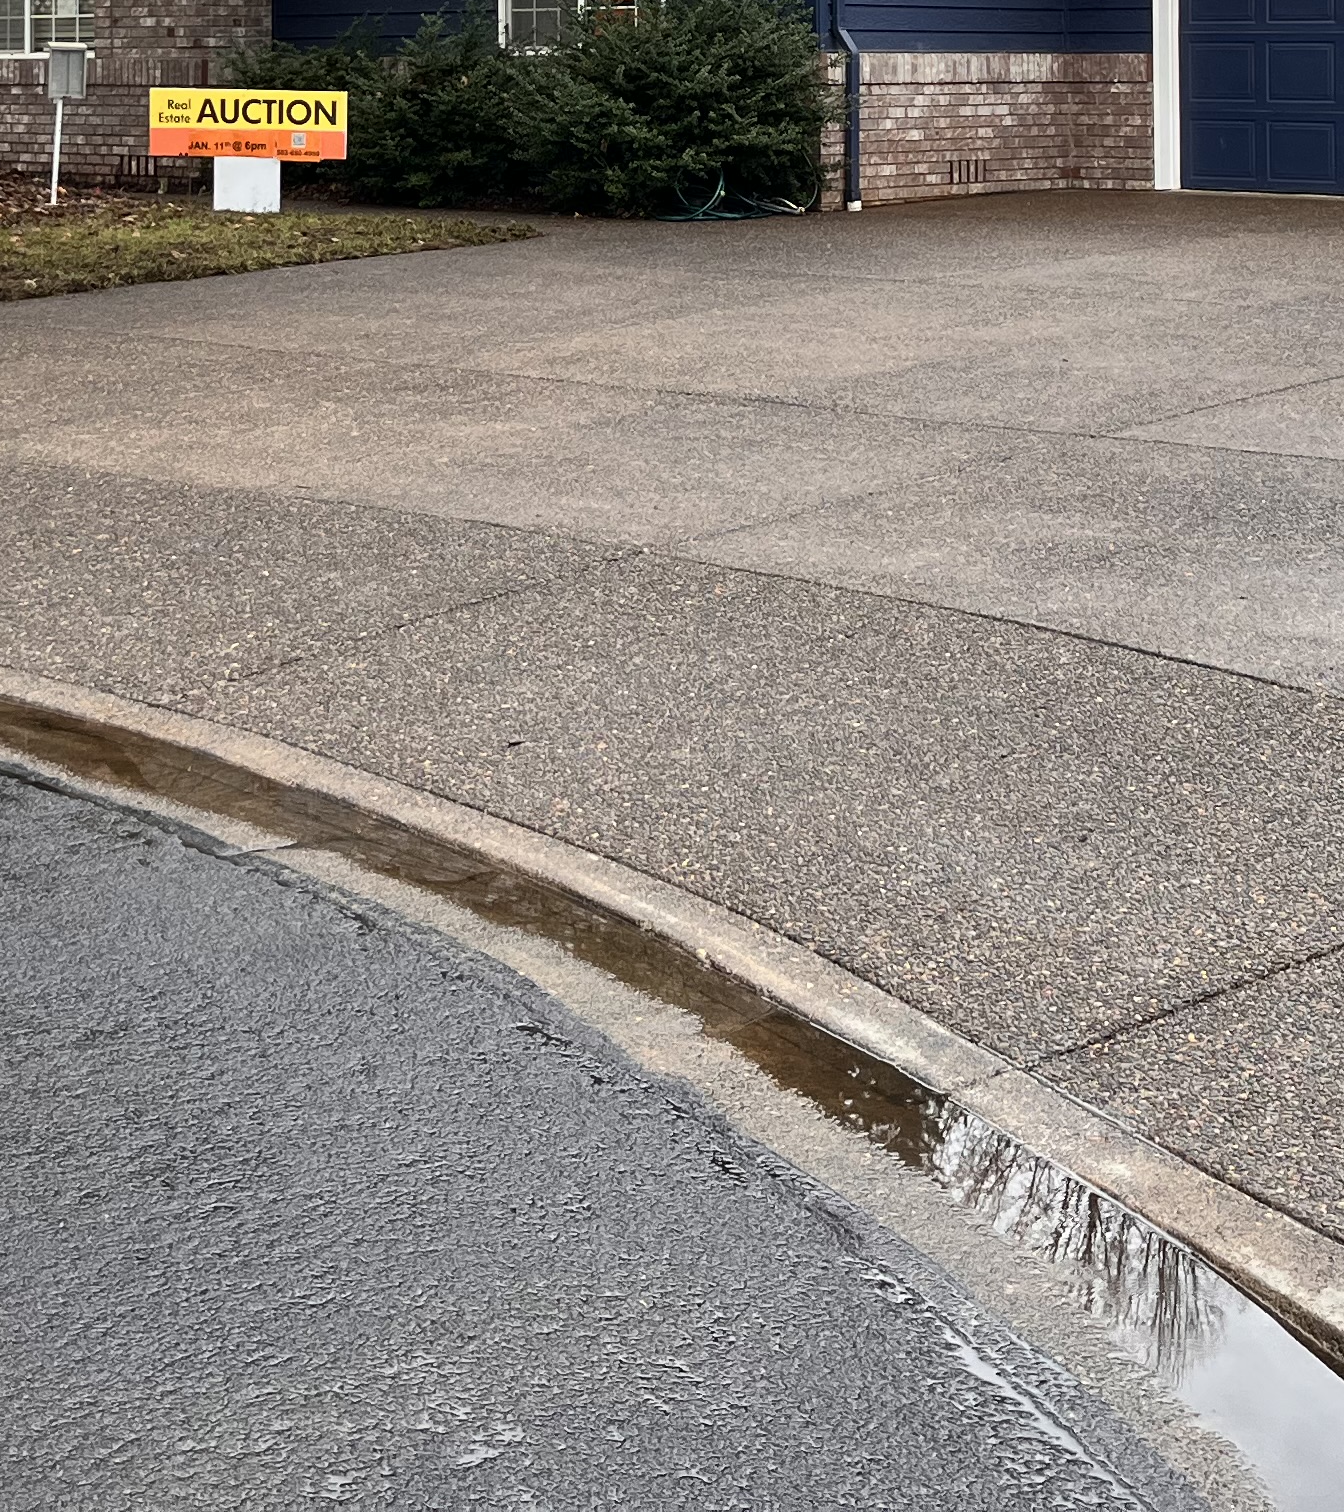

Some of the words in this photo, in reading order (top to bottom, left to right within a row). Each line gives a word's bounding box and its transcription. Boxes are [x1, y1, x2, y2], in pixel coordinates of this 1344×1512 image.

[167, 99, 191, 110] Real
[196, 98, 337, 126] AUCTION
[158, 112, 191, 124] Estate
[188, 141, 211, 150] JAN.
[232, 141, 243, 152] @
[245, 141, 267, 152] 6pm
